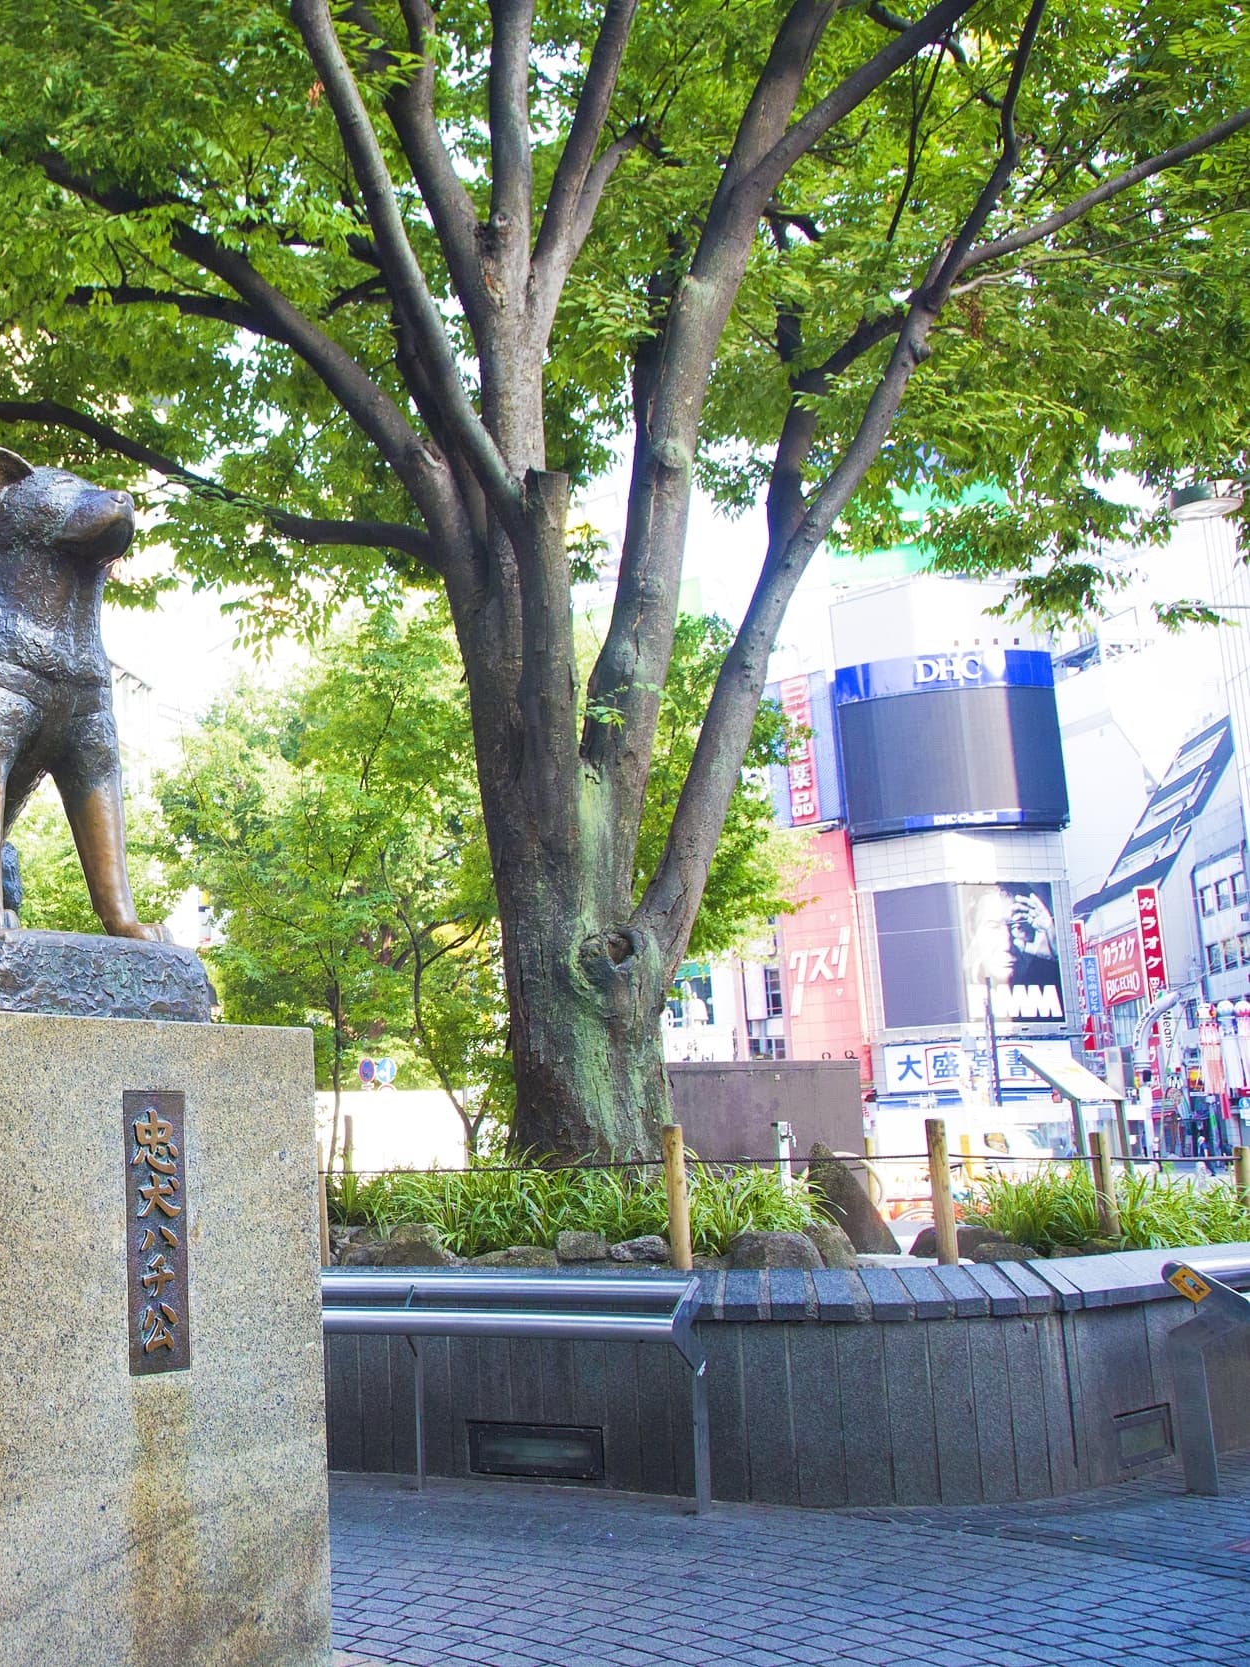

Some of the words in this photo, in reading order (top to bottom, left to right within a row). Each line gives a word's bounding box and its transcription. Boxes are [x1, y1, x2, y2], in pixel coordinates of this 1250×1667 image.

[914, 655, 983, 684] DHC
[1102, 937, 1136, 968] カラオケ
[1139, 897, 1163, 970] カラオケ
[789, 926, 851, 1017] クスリ
[131, 1108, 182, 1353] 忠犬ハチ公
